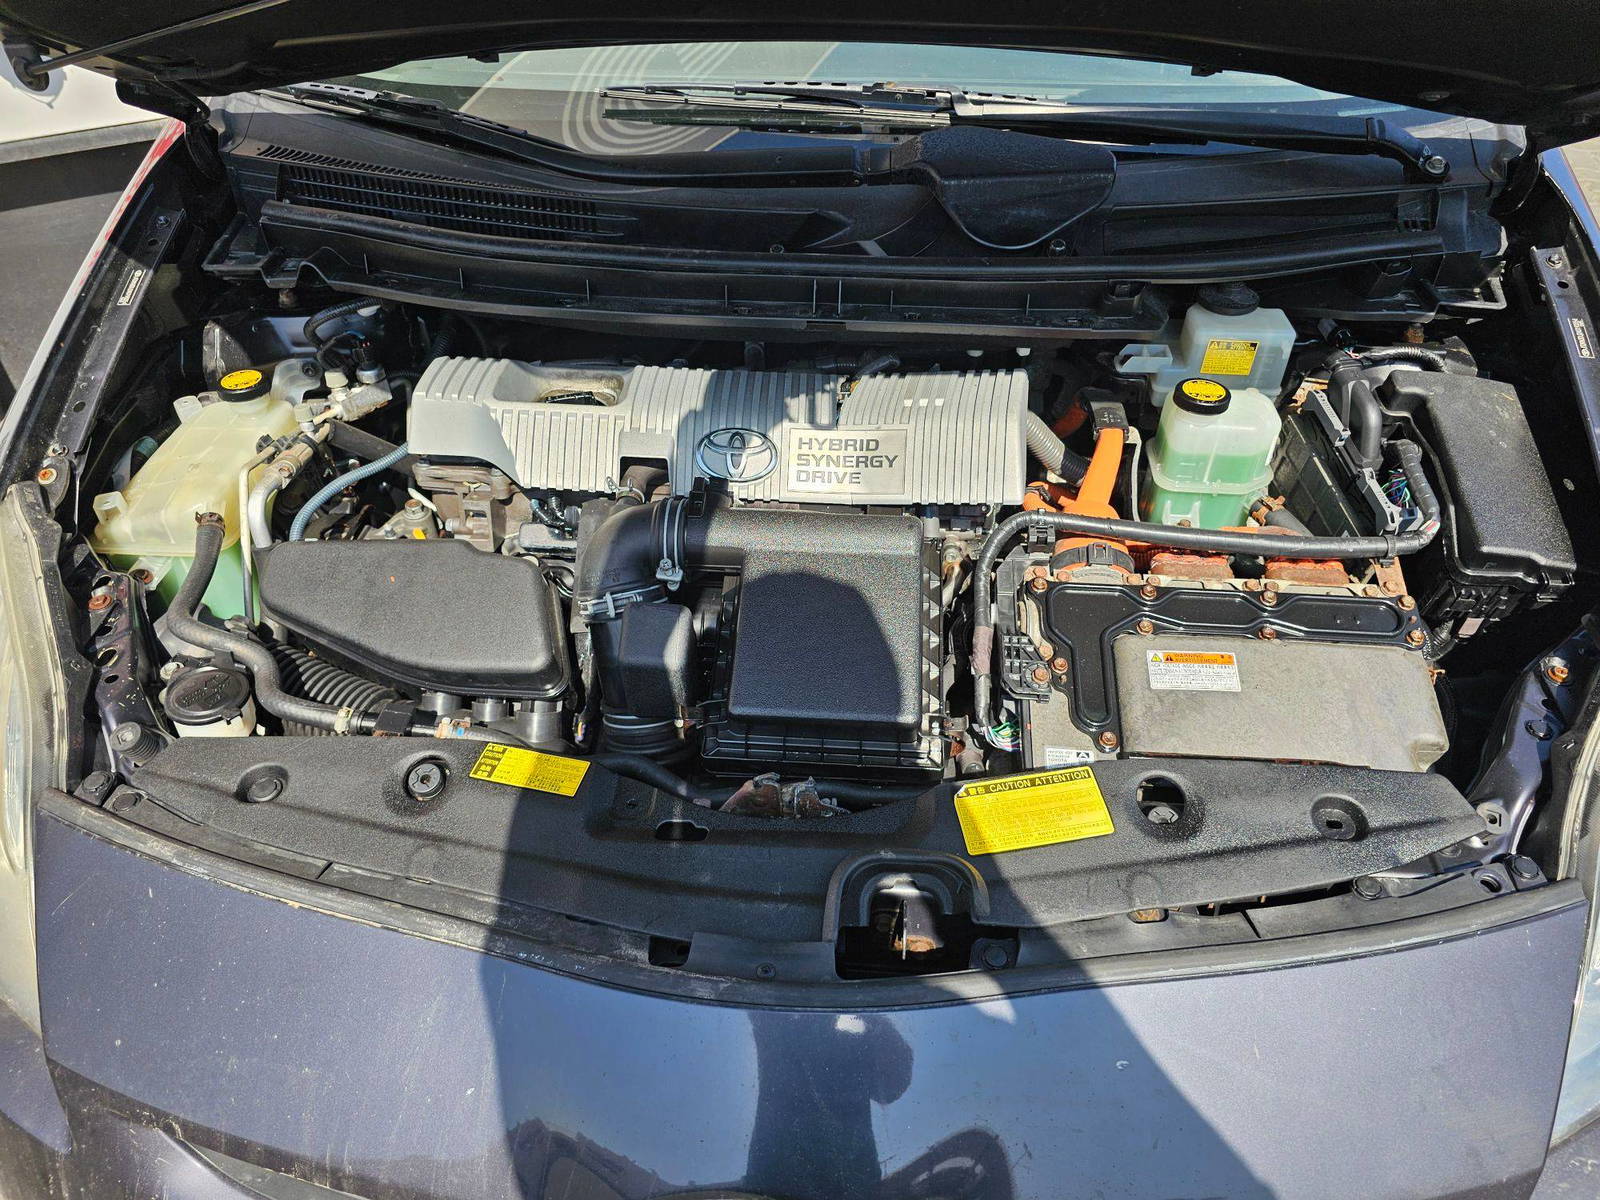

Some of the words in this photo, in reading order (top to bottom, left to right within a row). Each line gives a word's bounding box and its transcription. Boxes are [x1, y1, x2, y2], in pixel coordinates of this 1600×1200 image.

[798, 437, 880, 452] HYBRID
[796, 454, 899, 468] SYNERGY
[796, 470, 862, 484] DRIVE
[989, 779, 1031, 793] CAUTION
[1035, 769, 1089, 786] ATTENTION
